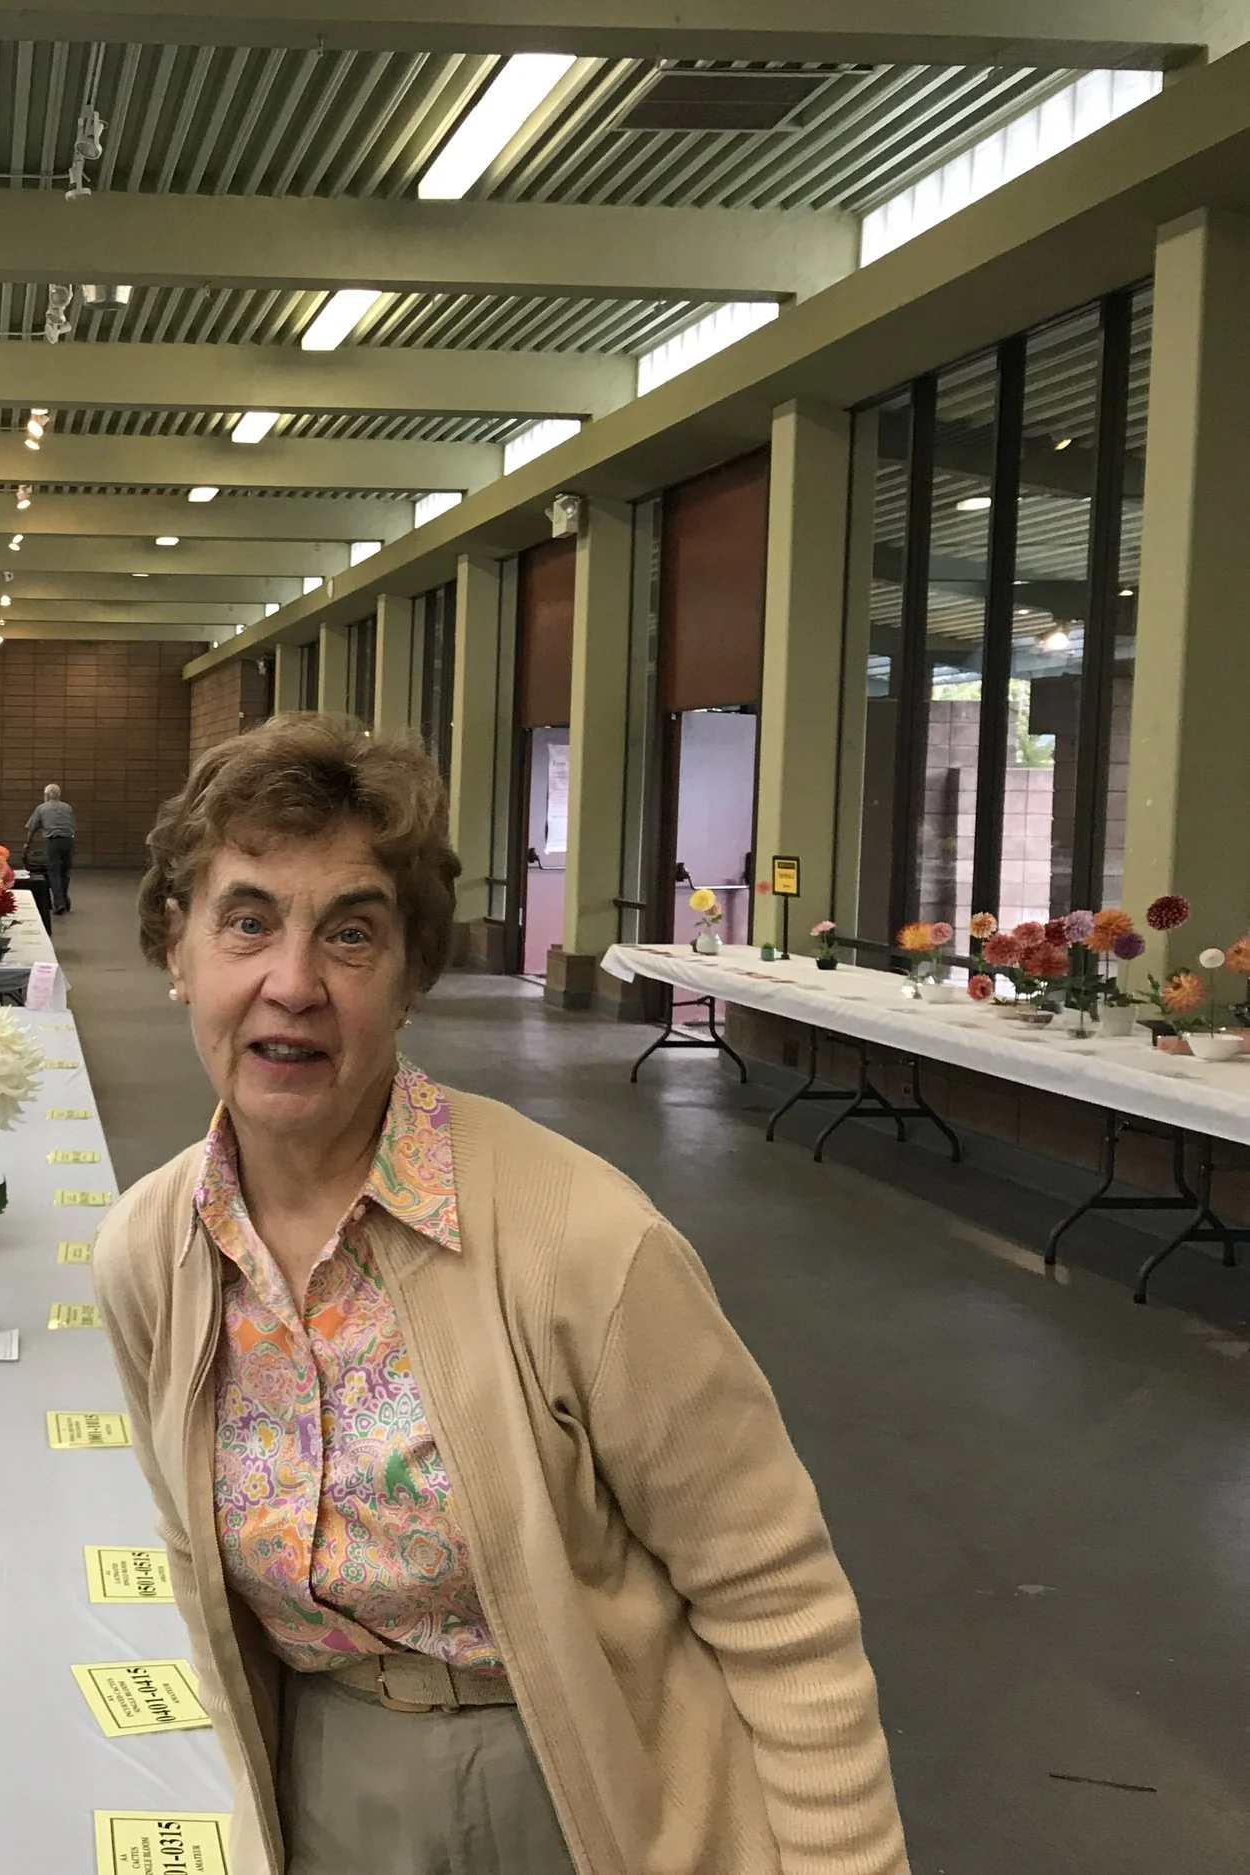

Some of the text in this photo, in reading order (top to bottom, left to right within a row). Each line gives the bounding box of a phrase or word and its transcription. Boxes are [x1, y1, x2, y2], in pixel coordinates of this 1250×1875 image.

[131, 1552, 157, 1596] 0501-0515
[106, 1677, 134, 1718] INCURVED CACTUS
[118, 1680, 141, 1713] SINGLE BLOOM
[126, 1667, 176, 1722] 0401-0415
[162, 1683, 181, 1704] AMATEUR
[119, 1854, 128, 1862] AA
[130, 1846, 141, 1869] CACTUS
[141, 1836, 154, 1875] INGLE BLOOM
[157, 1821, 188, 1875] 01-0315
[192, 1845, 204, 1872] AMATEUR
